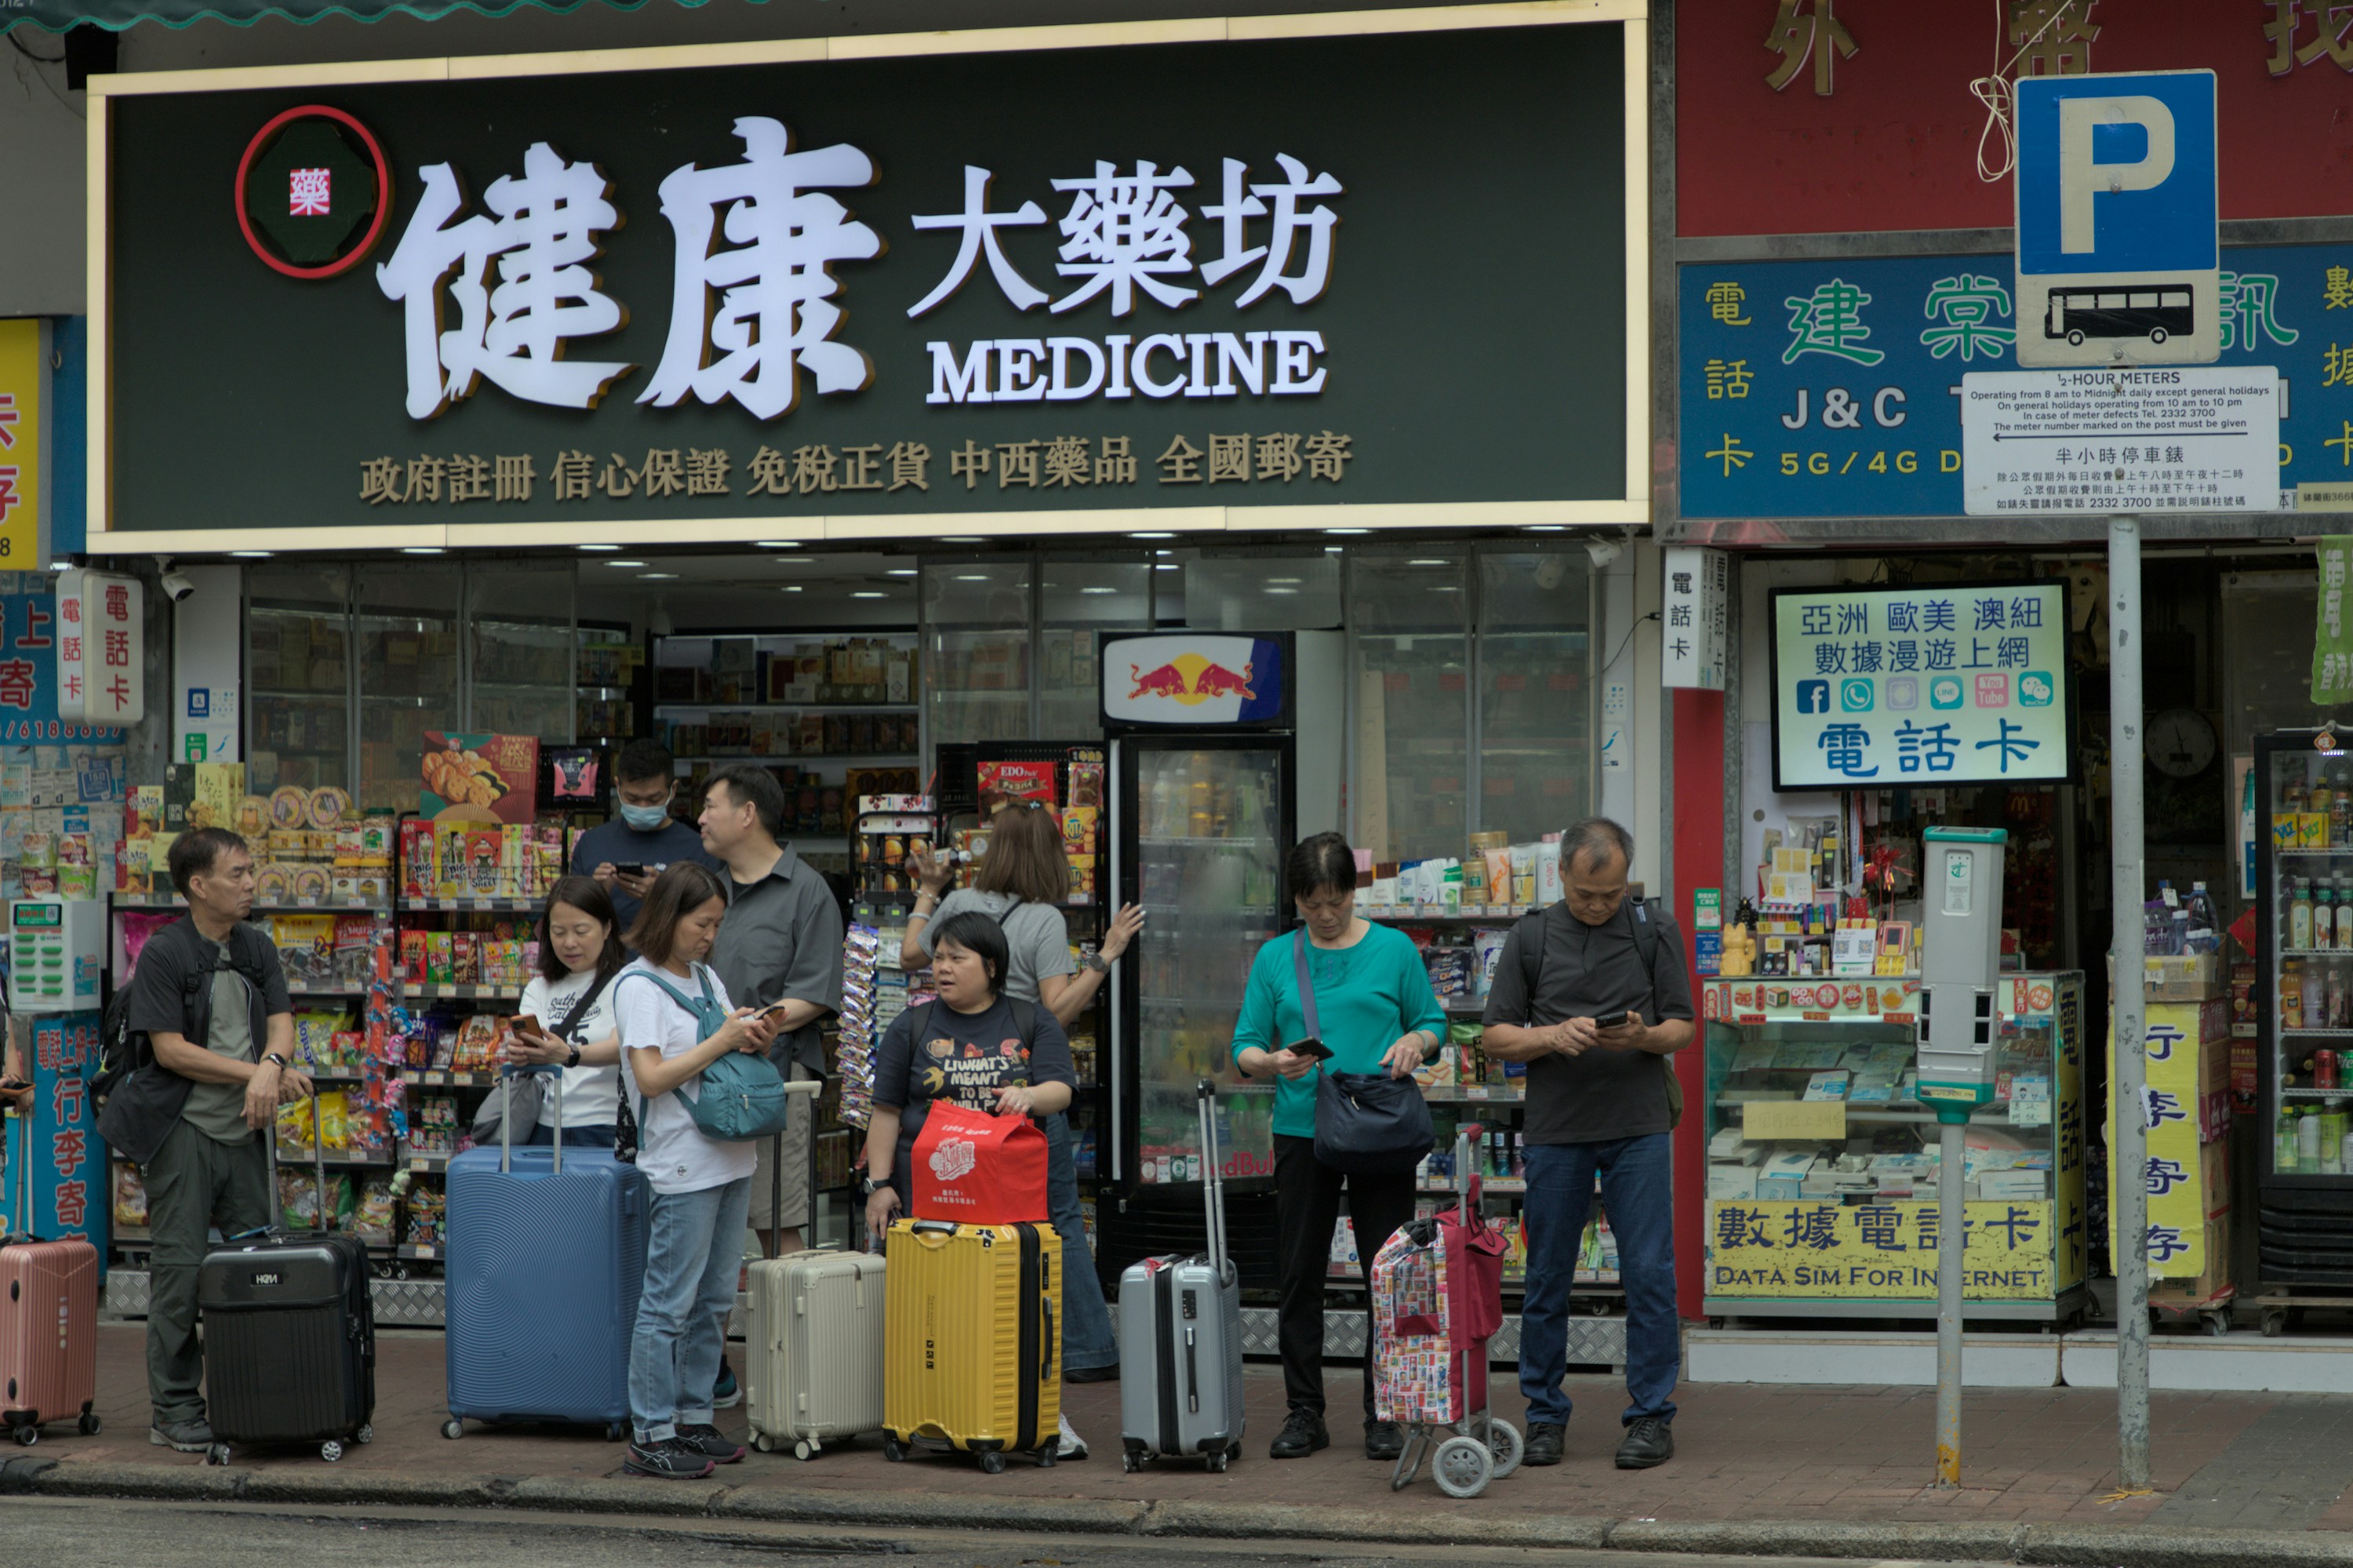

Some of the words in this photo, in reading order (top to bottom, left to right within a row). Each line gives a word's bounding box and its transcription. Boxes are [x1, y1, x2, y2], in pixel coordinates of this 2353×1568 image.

[2060, 95, 2176, 254] P
[289, 169, 330, 216] 藥
[376, 115, 880, 421] 健康
[907, 151, 1344, 319] 大藥坊
[1782, 271, 2300, 367] 建棠訊
[926, 330, 1328, 405] MEDICINE
[1704, 282, 1755, 477] 電話卡
[2121, 372, 2180, 384] METERS
[1970, 390, 2017, 401] Operating
[2020, 390, 2042, 398] from
[2045, 390, 2051, 398] 8
[2071, 390, 2081, 398] to
[2084, 388, 2126, 399] Midnight
[2129, 388, 2151, 398] daily
[2155, 388, 2188, 398] except
[2191, 387, 2226, 397] general
[2229, 386, 2270, 396] holidays
[1998, 402, 2011, 410] On
[2014, 401, 2049, 411] general
[2052, 400, 2091, 410] holidays
[2094, 399, 2140, 409] operating
[2143, 398, 2164, 407] from
[2167, 398, 2179, 407] 10
[2213, 398, 2224, 406] 10
[2228, 399, 2242, 408] pm
[1994, 422, 2011, 431] The
[2014, 422, 2041, 431] meter
[2082, 420, 2118, 430] marked
[2136, 420, 2151, 429] the
[2155, 420, 2176, 430] post
[2179, 420, 2202, 428] must
[2206, 419, 2218, 427] be
[2220, 419, 2246, 429] given
[2060, 411, 2070, 420] of
[2103, 409, 2139, 419] defects
[2141, 409, 2157, 418] Tel.
[2161, 409, 2186, 417] 2332
[2190, 408, 2216, 417] 3700
[359, 453, 536, 504] 政府註冊
[550, 447, 730, 501] 信心保證
[951, 435, 1138, 491] 中西藥品
[1155, 430, 1353, 486] 全國郵寄
[1780, 449, 1918, 476] 5G/4G
[2056, 446, 2184, 465] 半小時停車錶
[2089, 497, 2118, 508] 2332
[2122, 497, 2151, 508] 3700
[1669, 573, 1693, 660] 電話卡
[1801, 602, 1869, 636] 亞洲
[1887, 599, 1956, 634] 歐美
[1973, 596, 2043, 630] 澳紐
[62, 598, 82, 700] 電話卡
[105, 585, 129, 711] 電話卡
[1815, 636, 2030, 675] 數據漫遊上網
[1937, 688, 1955, 697] LINE
[1978, 690, 2004, 704] Tube
[1984, 677, 2001, 687] You
[1817, 718, 2040, 777] 電話卡
[1001, 766, 1024, 777] EDO
[1546, 862, 1555, 888] evian
[37, 1025, 99, 1071] 電話上網卡
[951, 1071, 1002, 1086] MEANT
[959, 1086, 976, 1099] TO
[978, 1086, 992, 1100] BE
[53, 1077, 89, 1242] 行李寄
[1717, 1205, 2040, 1251] 數據電話卡
[1912, 1267, 2043, 1287] INERNET
